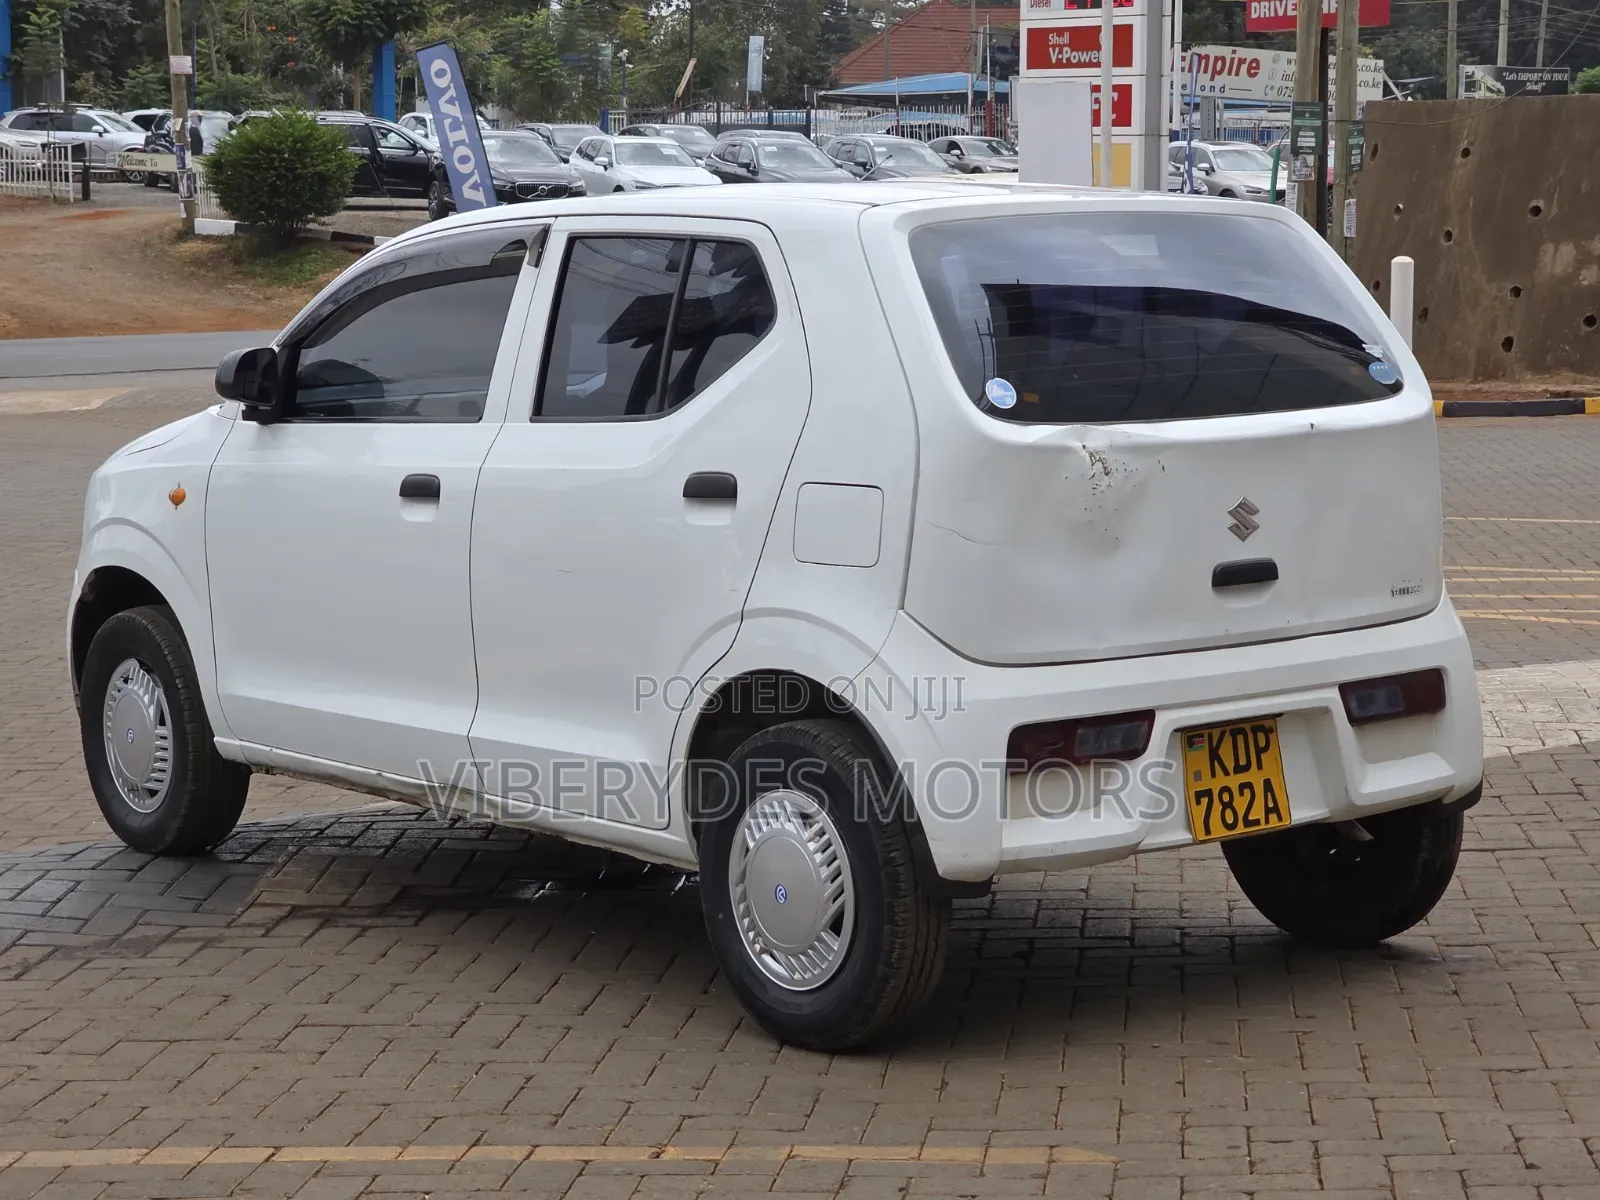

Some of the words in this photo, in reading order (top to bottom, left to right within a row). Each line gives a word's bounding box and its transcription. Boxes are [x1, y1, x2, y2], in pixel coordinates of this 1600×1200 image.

[1048, 32, 1070, 45] Shell
[117, 153, 148, 168] Welcome
[149, 157, 158, 167] To
[1208, 724, 1272, 778] KDP
[1194, 777, 1284, 836] 782A
